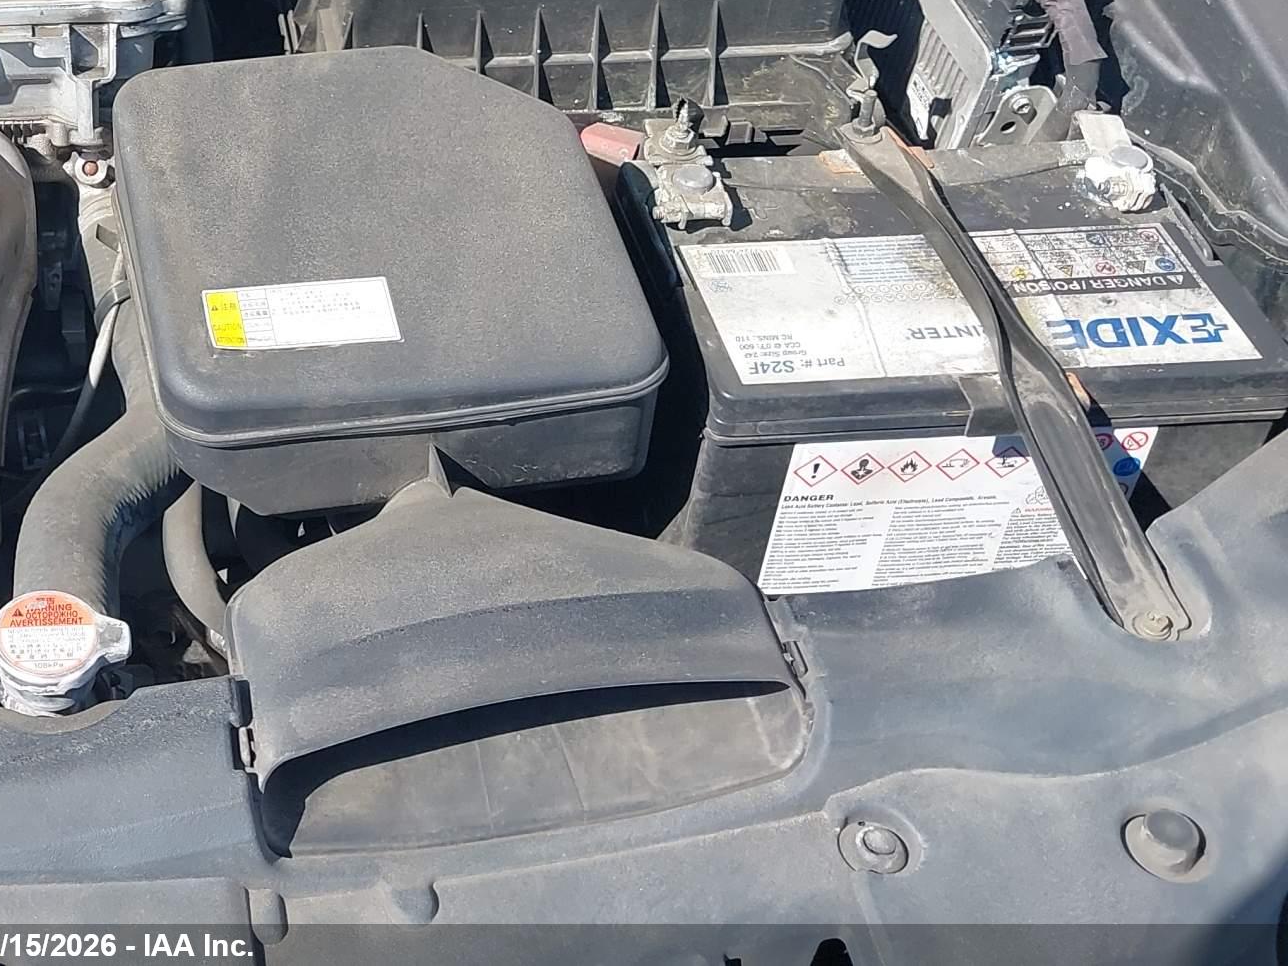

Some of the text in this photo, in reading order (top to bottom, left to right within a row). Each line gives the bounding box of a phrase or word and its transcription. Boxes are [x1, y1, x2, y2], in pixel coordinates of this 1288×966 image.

[1045, 313, 1228, 352] EXIDE
[782, 349, 807, 357] Group
[748, 359, 795, 375] S24F
[815, 356, 845, 370] Part
[783, 494, 834, 502] DANGER
[9, 617, 82, 627] AVERTISSEMENT
